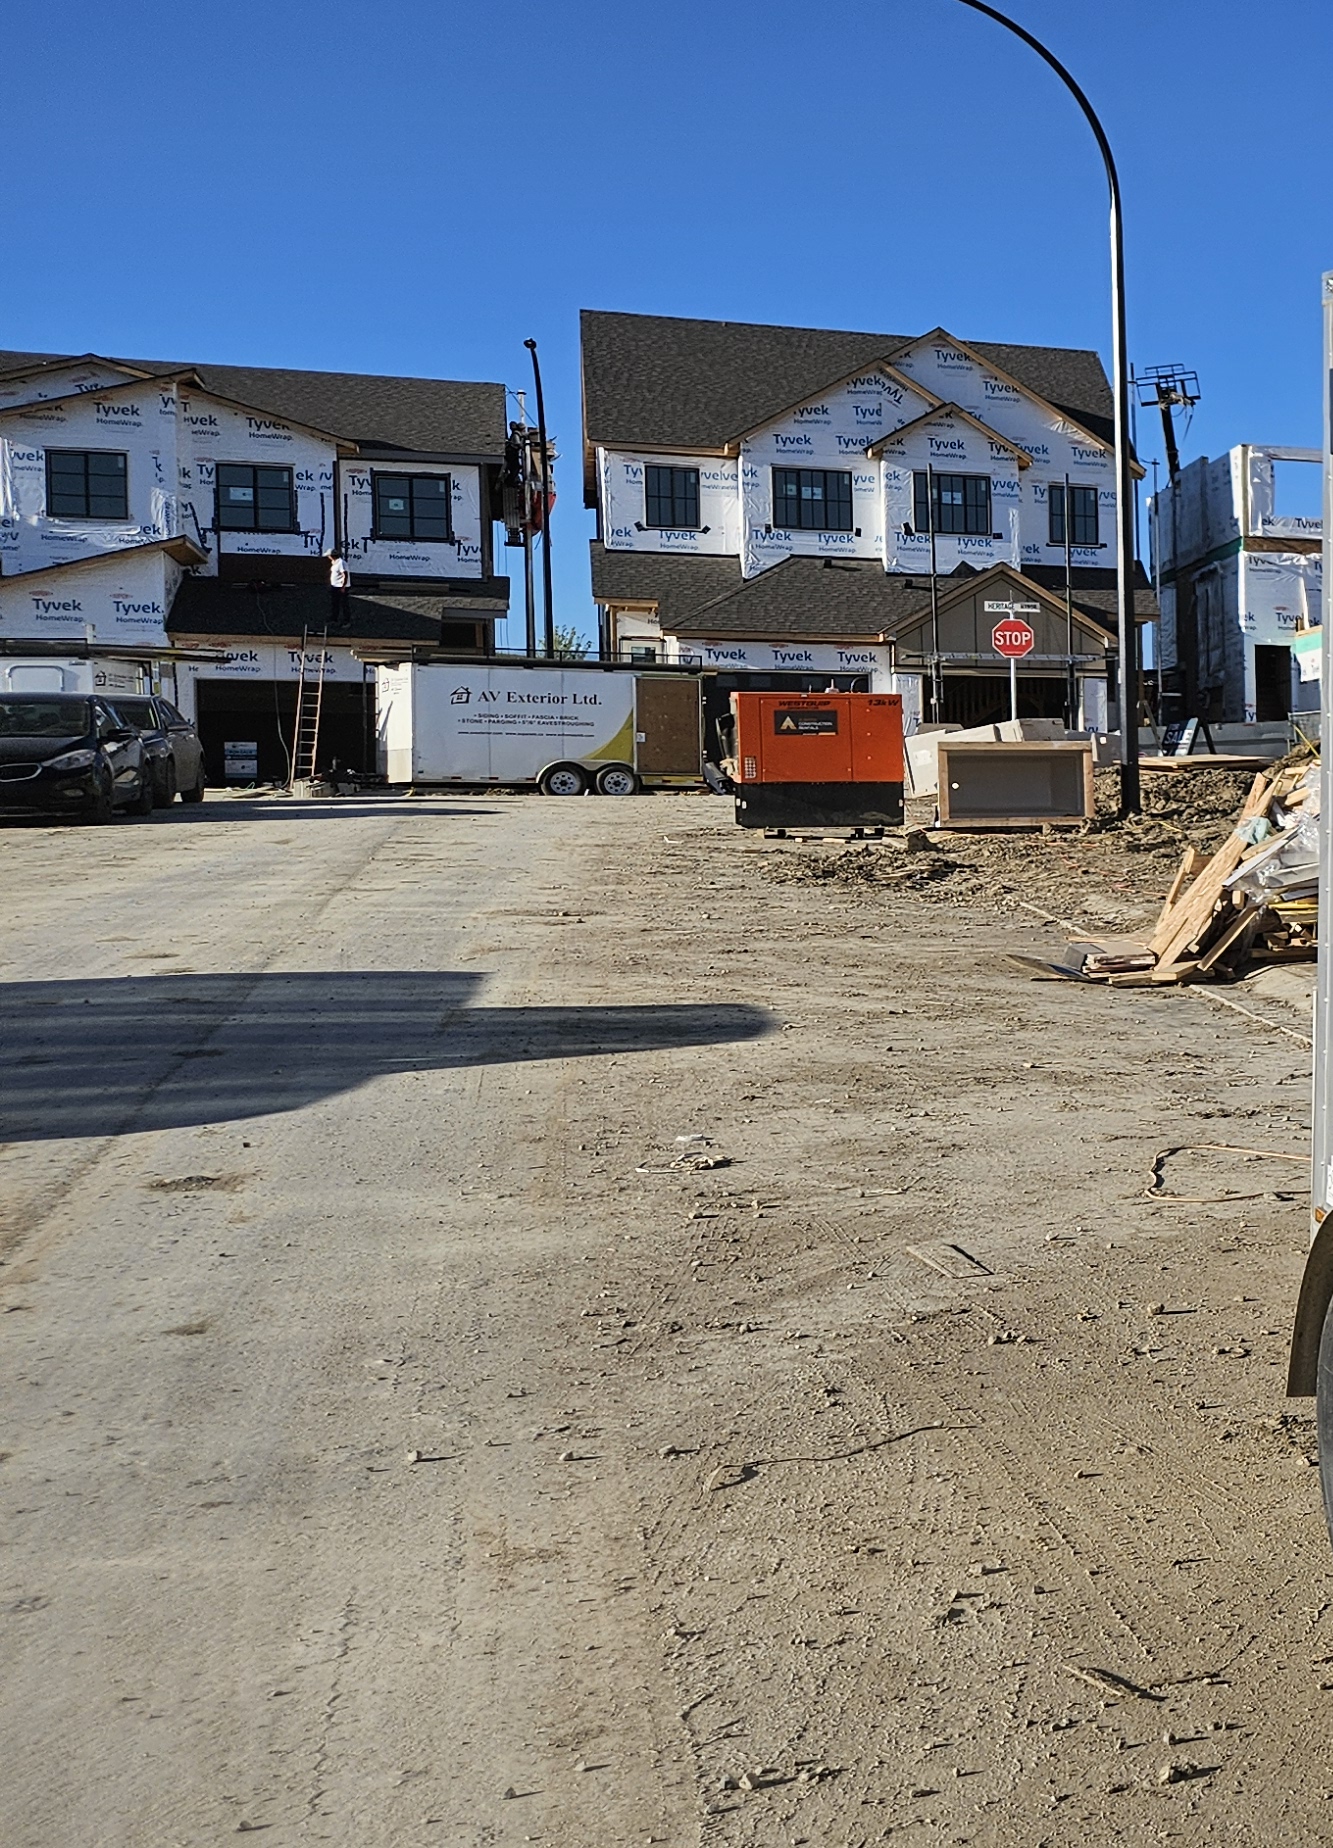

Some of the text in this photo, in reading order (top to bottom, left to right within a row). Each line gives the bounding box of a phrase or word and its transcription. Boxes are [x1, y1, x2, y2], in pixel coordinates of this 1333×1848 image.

[93, 402, 141, 418] Tyvek
[248, 431, 294, 442] HomeWrap
[772, 433, 812, 447] Tyvek
[927, 437, 965, 451] Tyvek
[1070, 446, 1107, 460] Tyvek
[752, 528, 792, 542] Tyvek
[32, 598, 82, 614] Tyvek
[113, 600, 161, 616] Tyvek
[35, 613, 84, 623] HomeWrap
[995, 631, 1032, 646] STOP
[705, 648, 747, 663] Tyvek
[772, 649, 812, 664] Tyvek
[837, 651, 877, 666] Tyvek
[478, 690, 602, 706] AV Exterior Ltd.
[488, 718, 517, 726] PARGING
[531, 713, 554, 721] FASCIA
